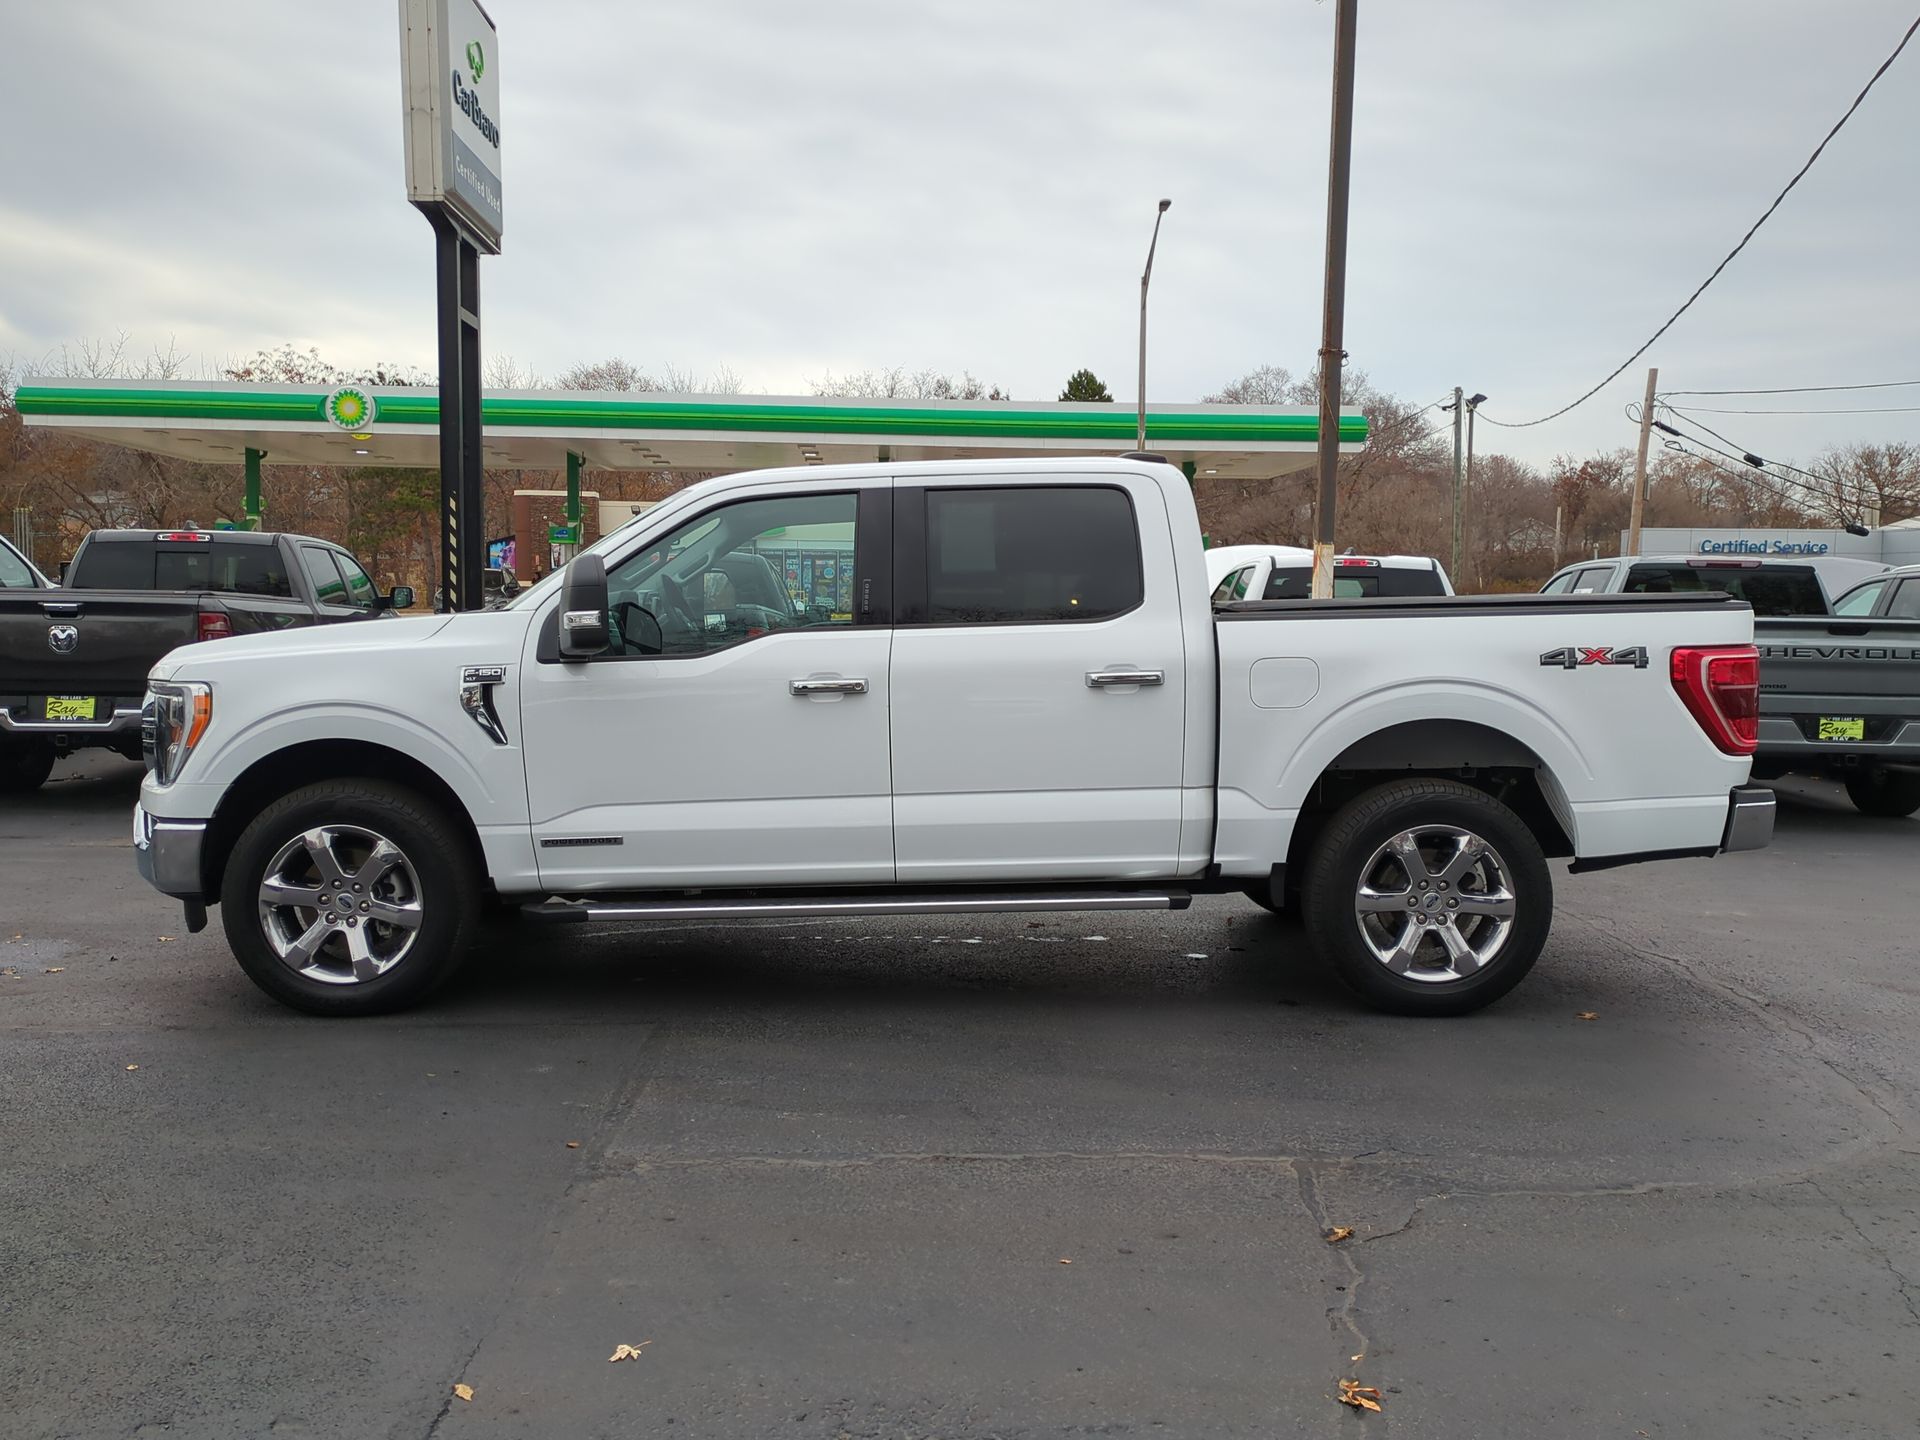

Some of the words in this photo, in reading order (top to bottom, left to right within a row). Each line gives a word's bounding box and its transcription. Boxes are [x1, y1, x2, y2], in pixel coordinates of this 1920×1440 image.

[453, 69, 500, 149] CarBravo
[456, 154, 486, 197] Certified
[486, 186, 501, 214] Used
[1700, 539, 1768, 554] Certified
[1773, 540, 1828, 554] Service
[1759, 647, 1920, 660] HEVROL
[465, 669, 501, 677] F-150
[47, 701, 79, 716] Ray
[1820, 722, 1848, 737] Ray
